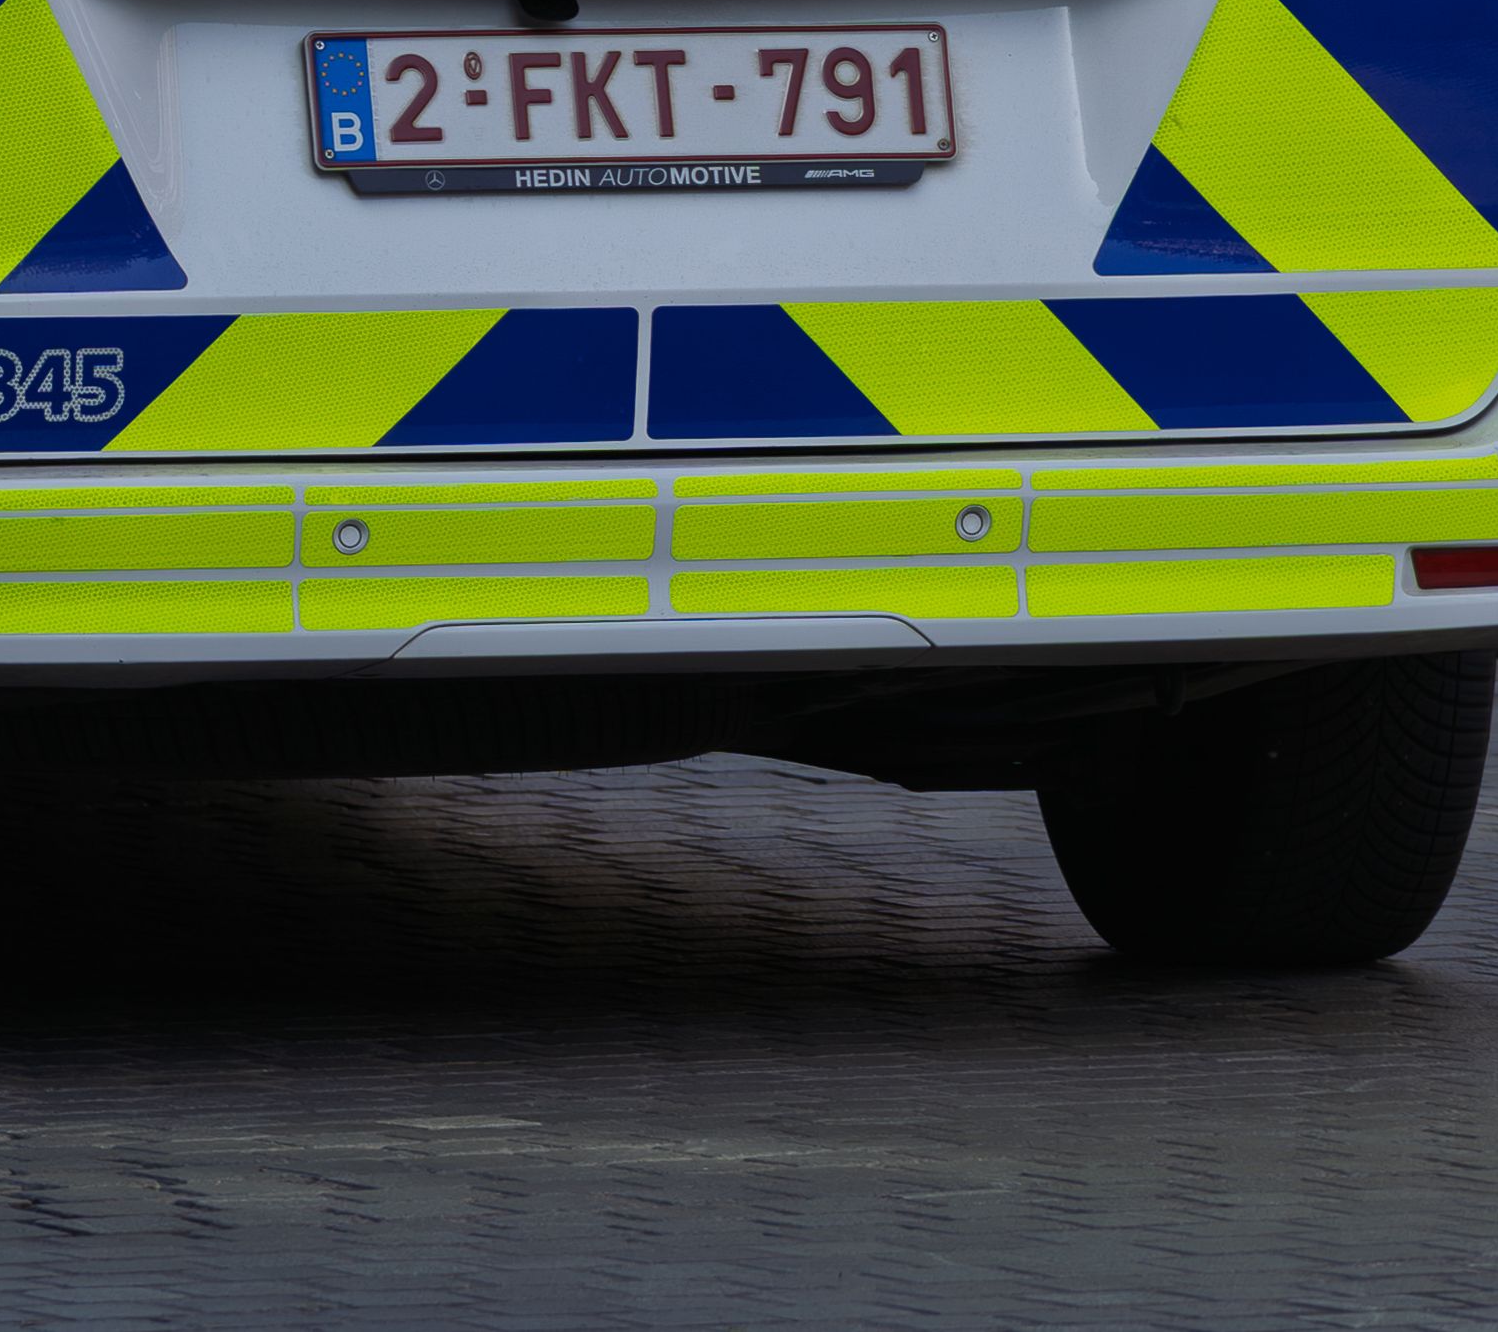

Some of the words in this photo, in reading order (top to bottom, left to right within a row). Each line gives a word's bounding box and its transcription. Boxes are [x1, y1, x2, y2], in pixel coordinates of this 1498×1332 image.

[385, 46, 928, 144] 2-FKT-791
[330, 111, 365, 153] B
[515, 169, 591, 188] HEDIN
[598, 166, 762, 188] AUTOMOTIVE
[829, 168, 875, 179] AMG
